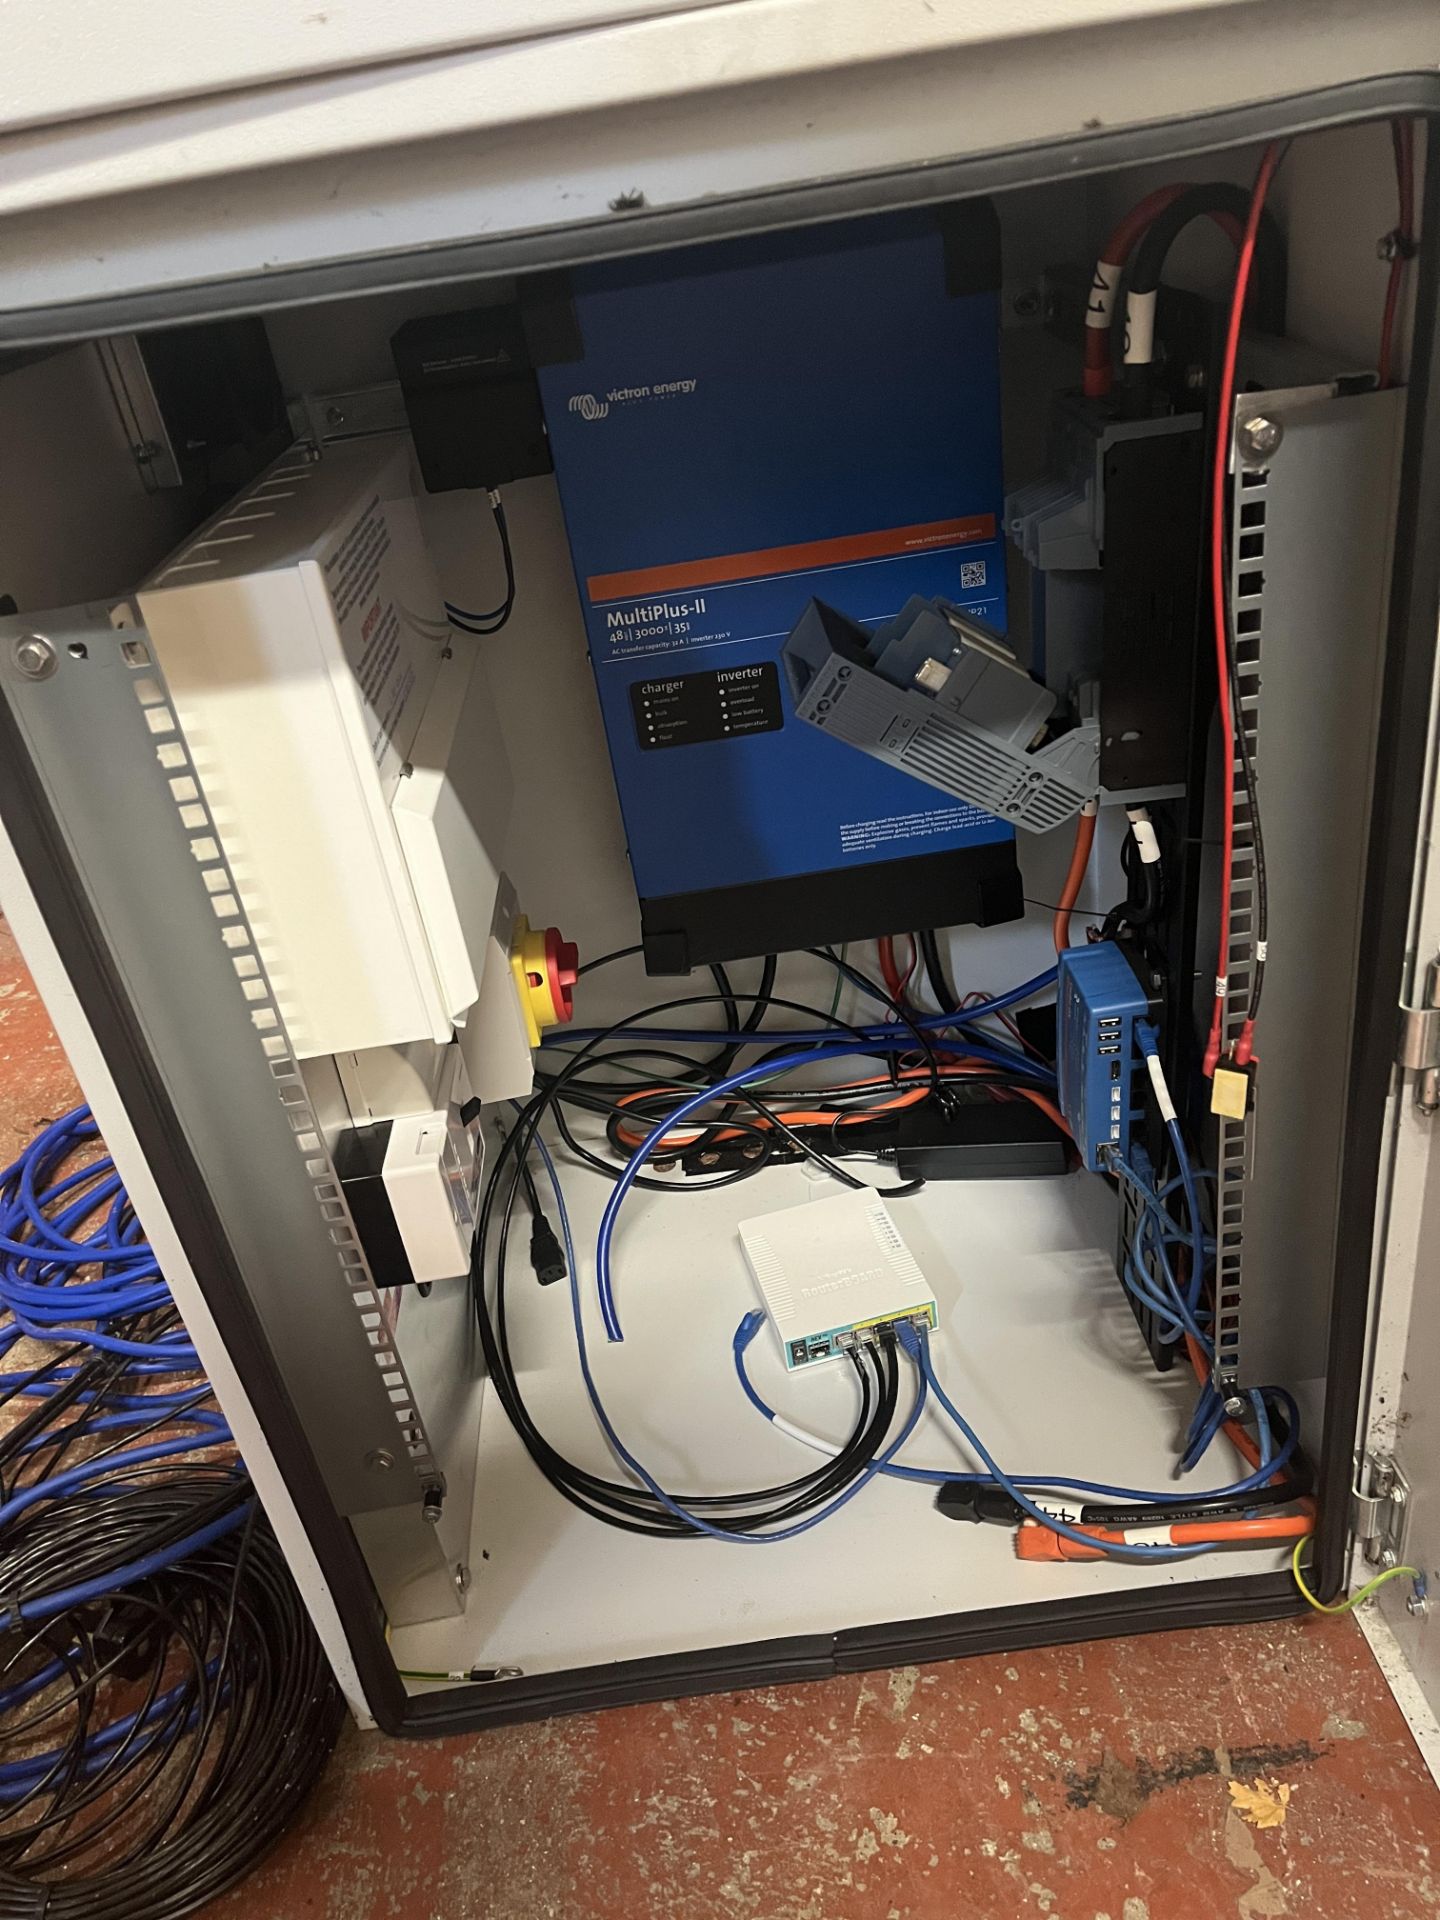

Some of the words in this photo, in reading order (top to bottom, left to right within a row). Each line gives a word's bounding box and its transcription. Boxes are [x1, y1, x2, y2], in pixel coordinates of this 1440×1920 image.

[606, 387, 650, 402] victron
[653, 379, 697, 393] energy
[607, 599, 706, 628] MultiPlus-II
[690, 633, 713, 642] inverter
[717, 667, 763, 683] inverter
[642, 680, 684, 695] charger
[743, 706, 764, 716] battery
